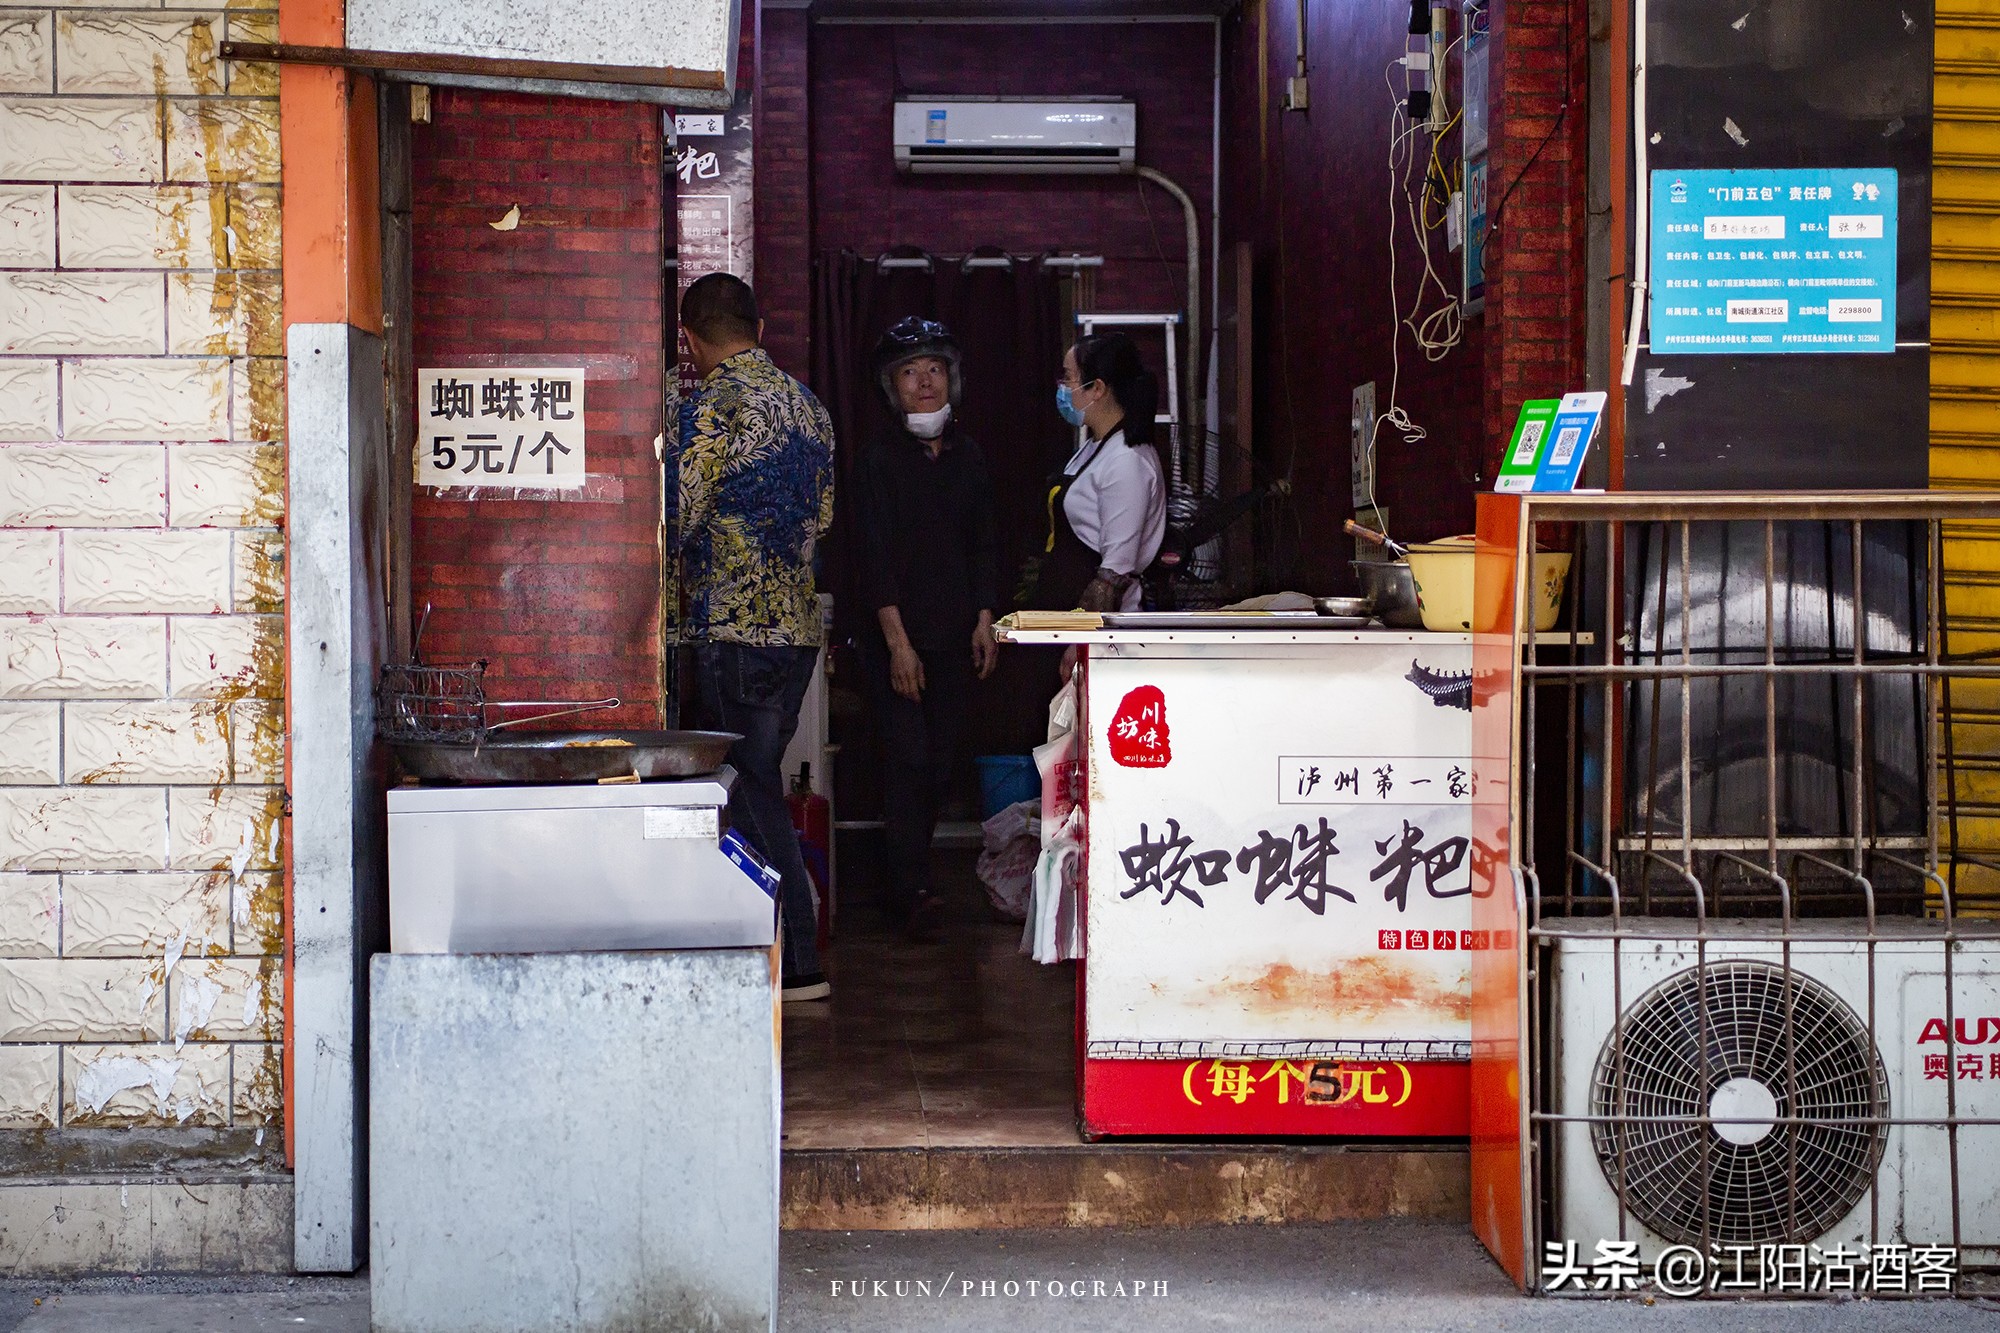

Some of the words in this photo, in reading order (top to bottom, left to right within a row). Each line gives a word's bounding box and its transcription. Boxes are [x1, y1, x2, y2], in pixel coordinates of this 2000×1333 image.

[677, 118, 717, 132] 第一家
[677, 145, 720, 184] 粑
[1731, 307, 1784, 316] 南城街道滨江社区
[430, 377, 575, 421] 蜘蛛粑
[432, 431, 572, 475] 5元/个
[1298, 763, 1470, 800] 泸州第一家
[1118, 817, 1473, 916] 蜘蛛粑
